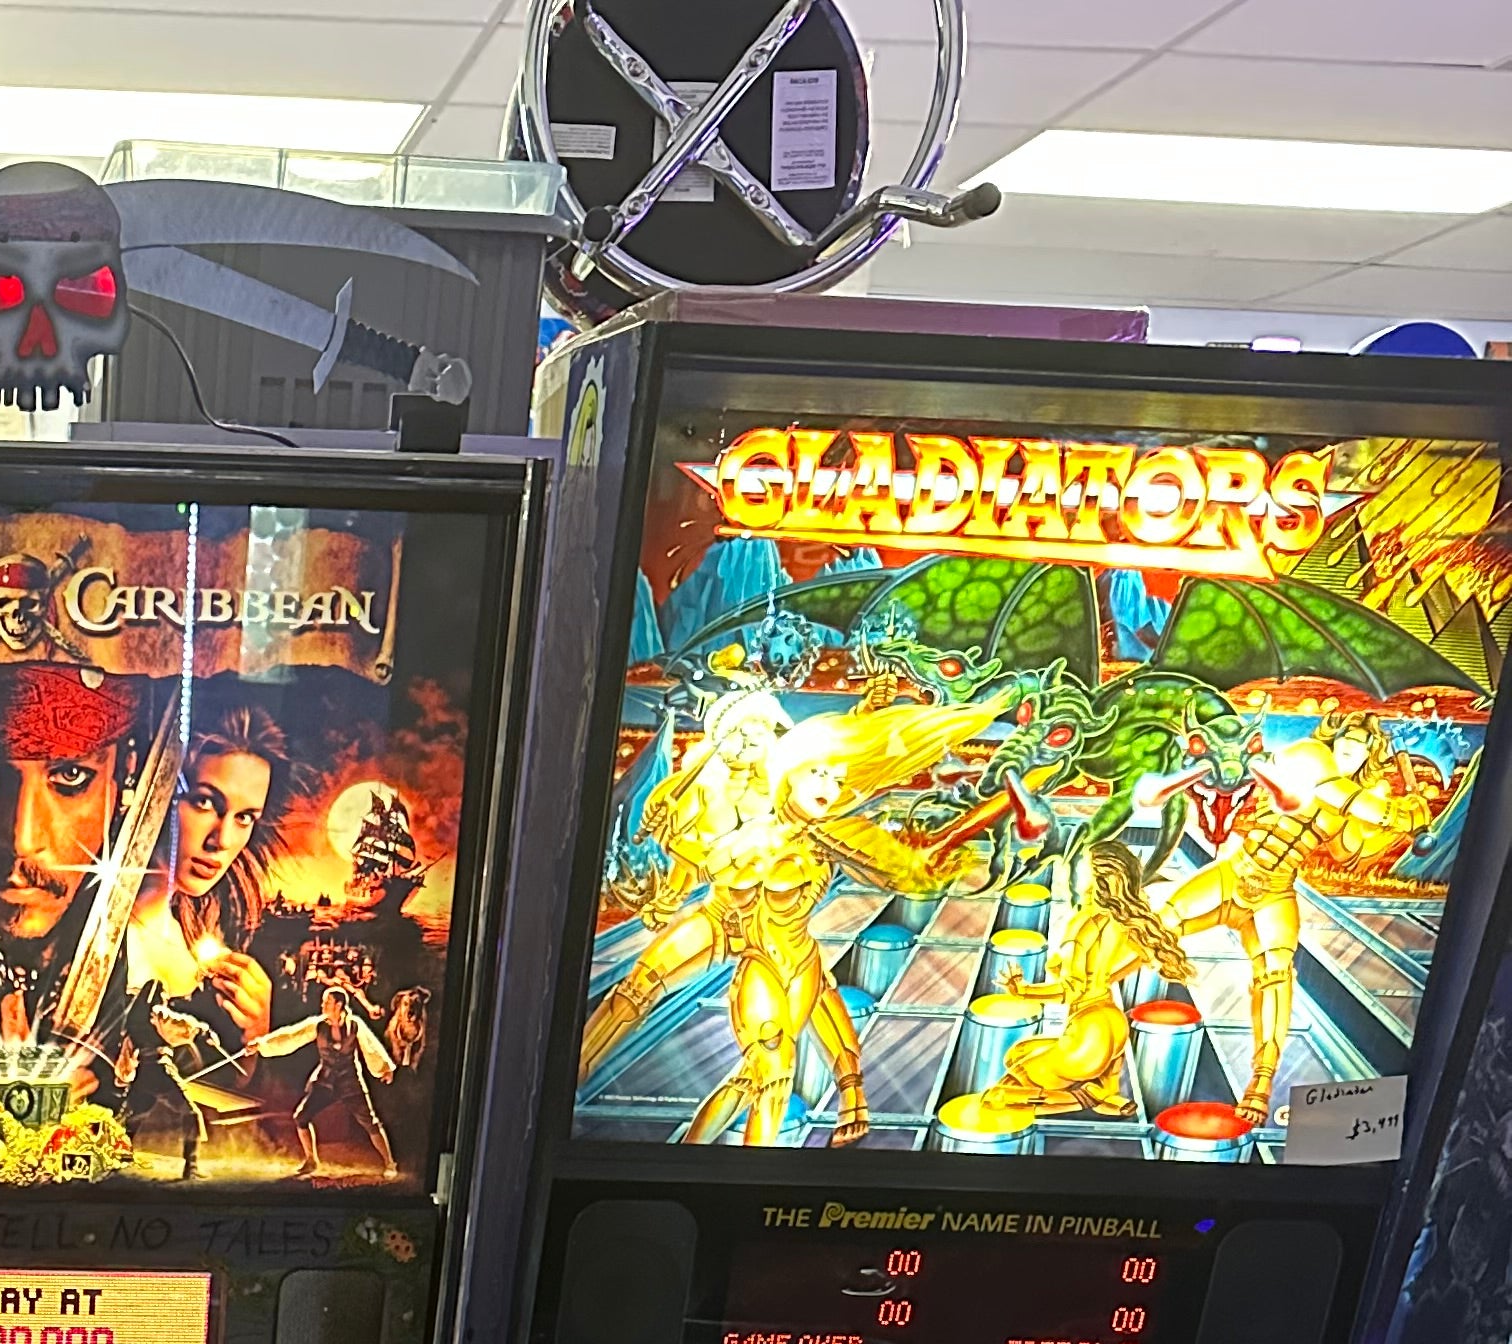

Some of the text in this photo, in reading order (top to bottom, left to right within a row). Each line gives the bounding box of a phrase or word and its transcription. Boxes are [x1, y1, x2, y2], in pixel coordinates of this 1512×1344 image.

[716, 426, 1333, 556] GLADIATORS
[63, 566, 381, 635] CARIBBEAN
[763, 1201, 1162, 1239] THE Premier NAME IN PINBALL
[109, 1215, 171, 1251] NO
[199, 1217, 334, 1257] TALES
[887, 1250, 922, 1276] 00
[1121, 1257, 1156, 1283] 00
[60, 1288, 103, 1316] AT
[878, 1300, 912, 1326] 00
[1111, 1306, 1146, 1333] 00
